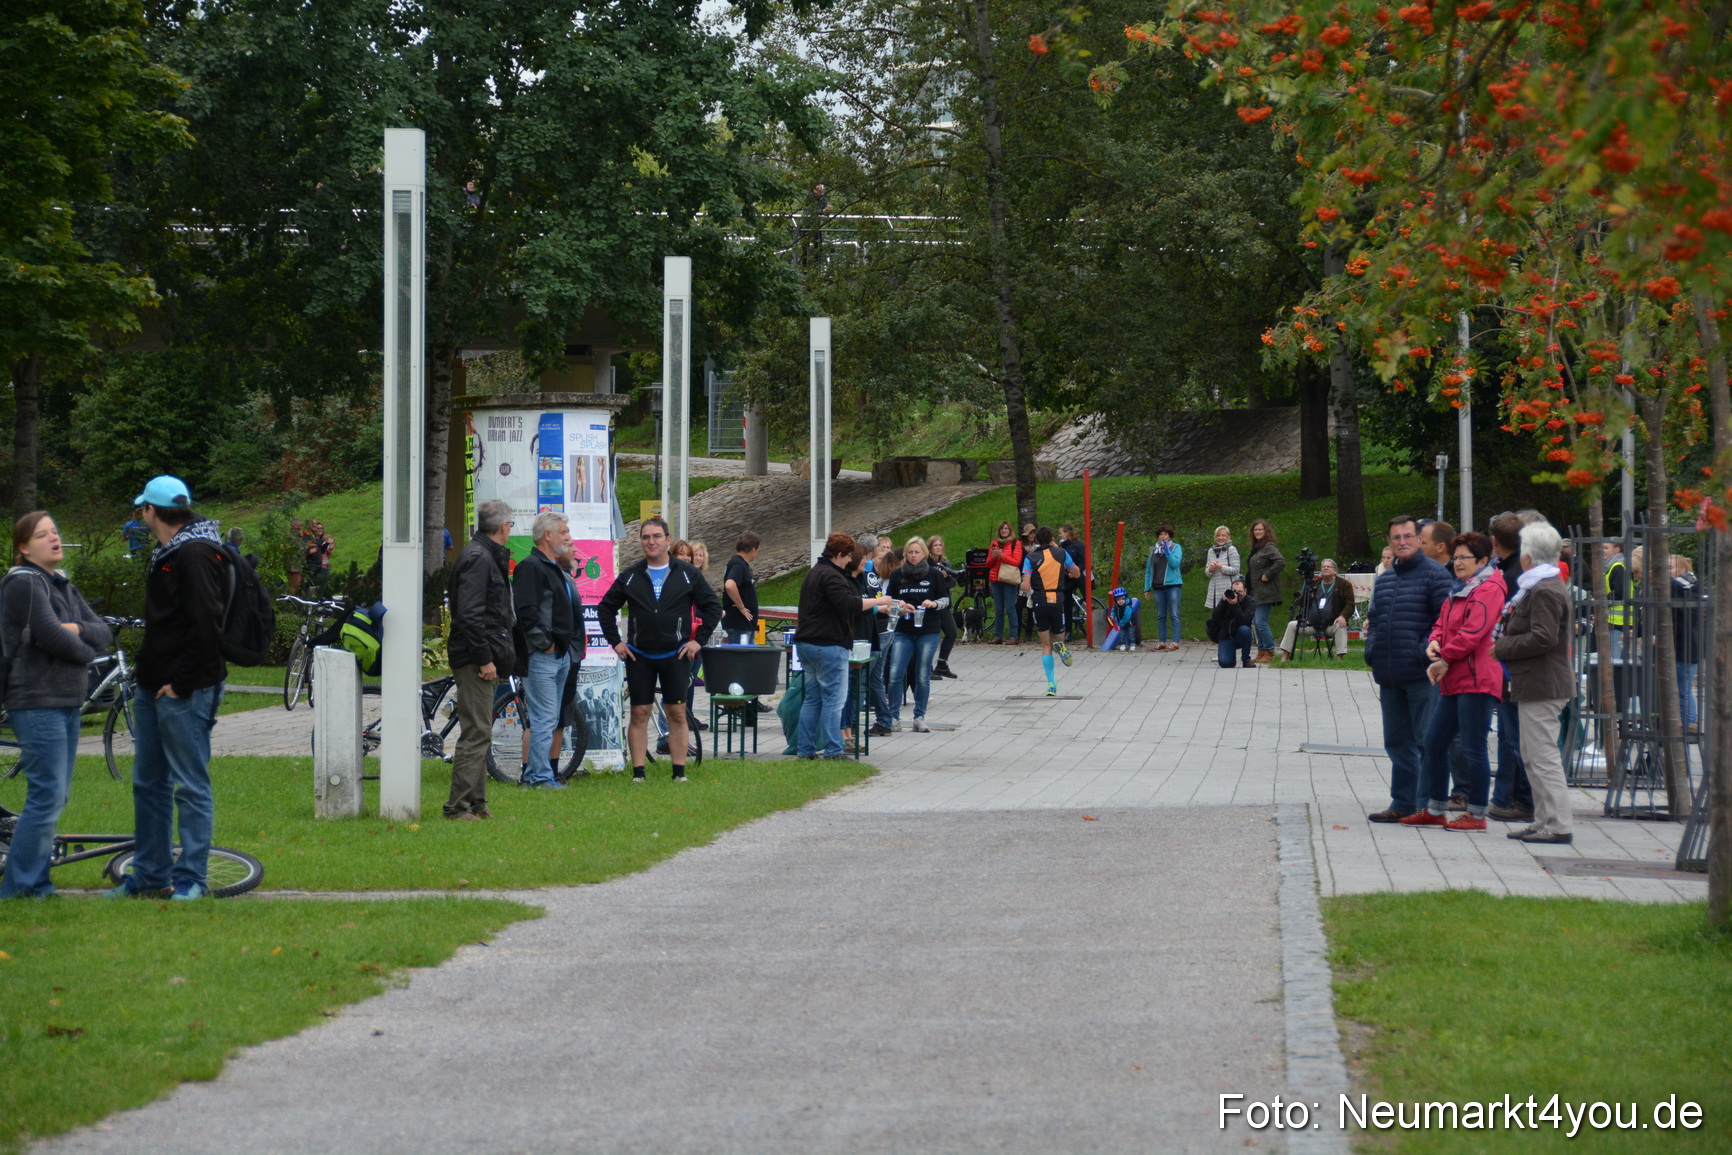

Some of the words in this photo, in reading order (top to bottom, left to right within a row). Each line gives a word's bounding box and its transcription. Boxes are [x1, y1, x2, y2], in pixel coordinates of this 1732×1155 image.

[487, 429, 506, 442] URBAN
[509, 429, 523, 443] JAZZ
[580, 440, 608, 450] SPLASH
[591, 637, 599, 647] 20
